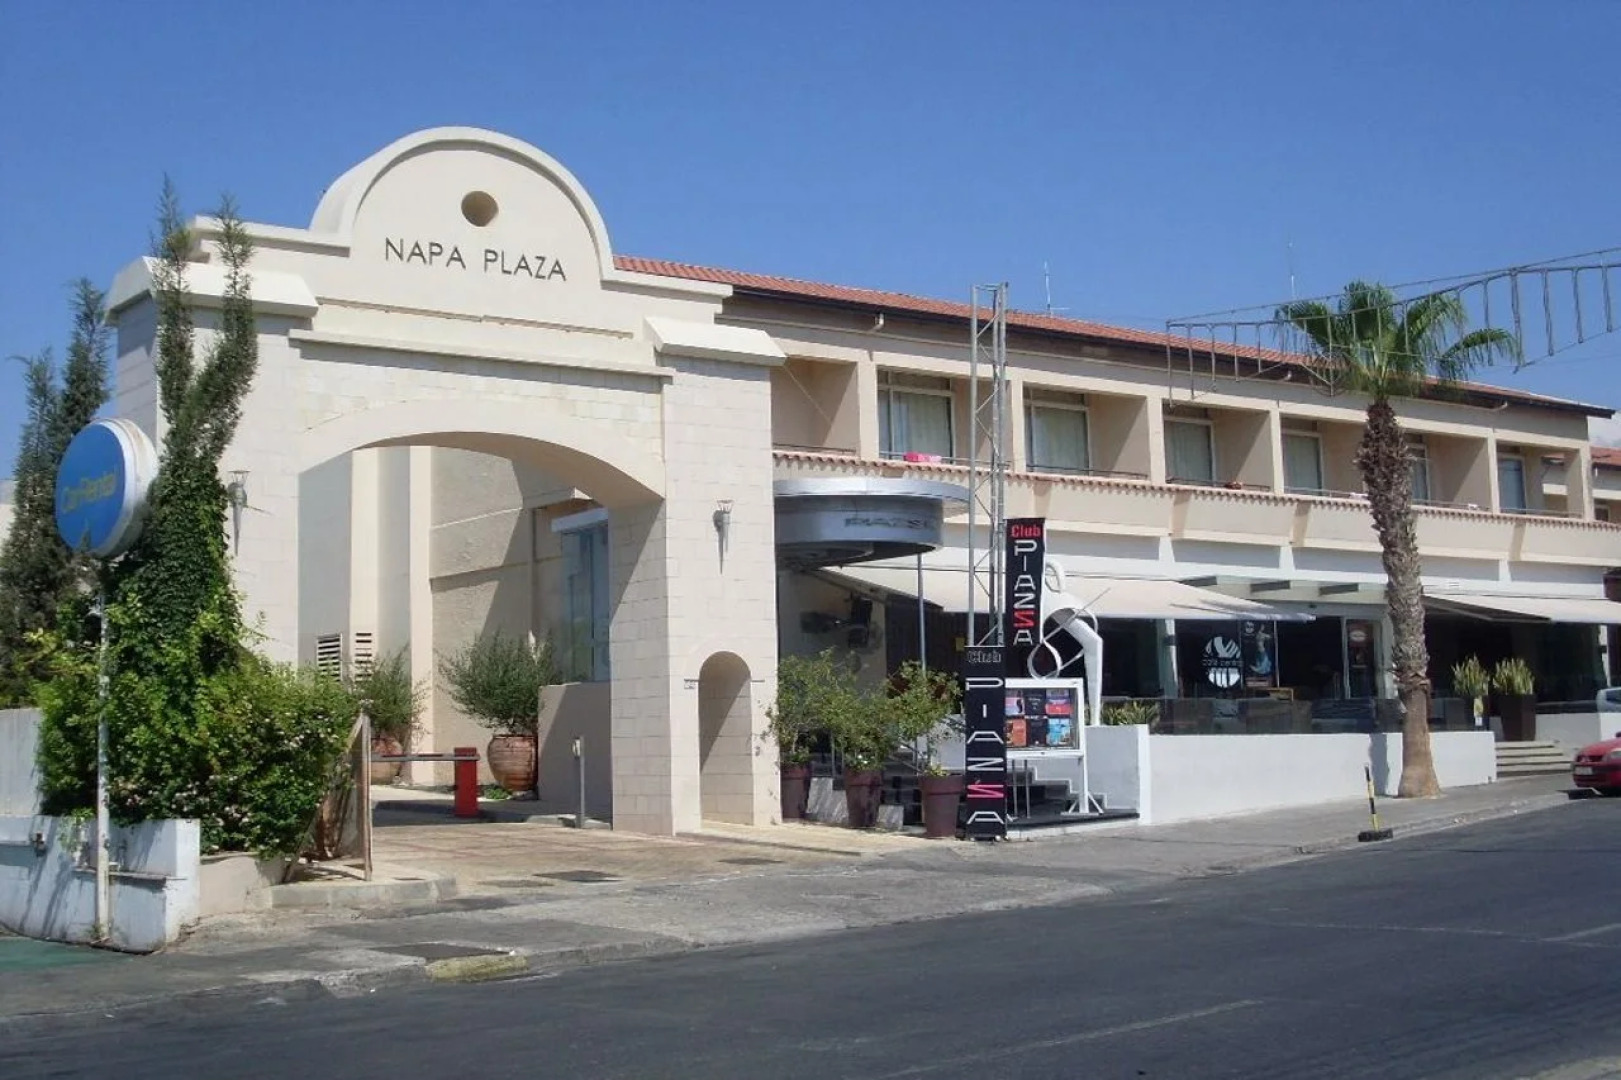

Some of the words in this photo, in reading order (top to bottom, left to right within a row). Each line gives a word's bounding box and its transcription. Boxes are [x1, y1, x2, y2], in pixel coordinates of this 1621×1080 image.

[385, 237, 466, 269] NAPA
[484, 248, 567, 281] PLAZA
[1011, 525, 1041, 537] Club
